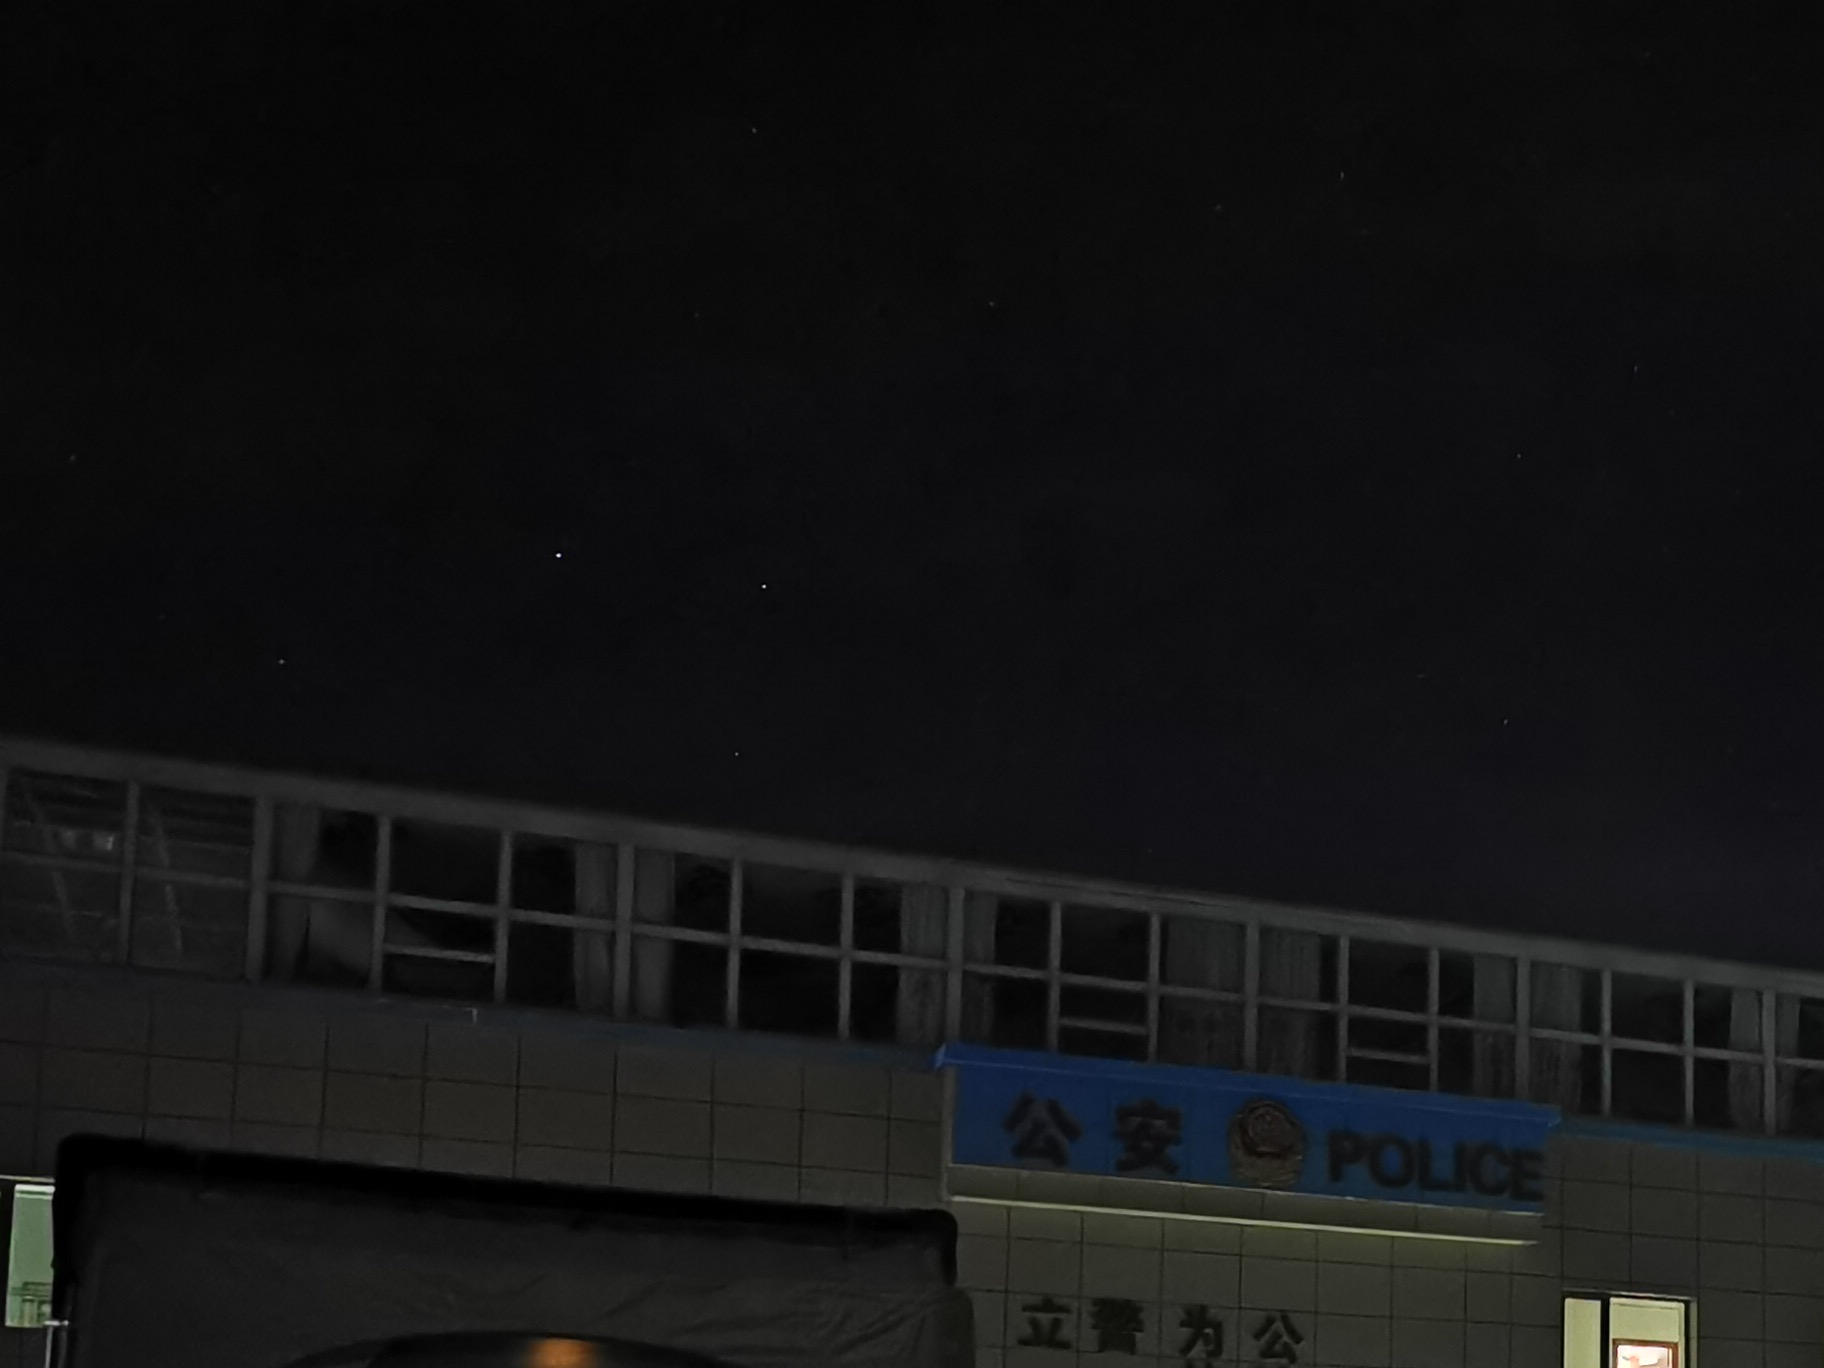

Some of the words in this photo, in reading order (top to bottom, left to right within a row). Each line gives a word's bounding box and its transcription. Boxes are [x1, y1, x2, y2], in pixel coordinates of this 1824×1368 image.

[1003, 1092, 1183, 1175] 公安
[1327, 1133, 1545, 1201] POLICE
[1018, 1298, 1304, 1364] 立警为公
